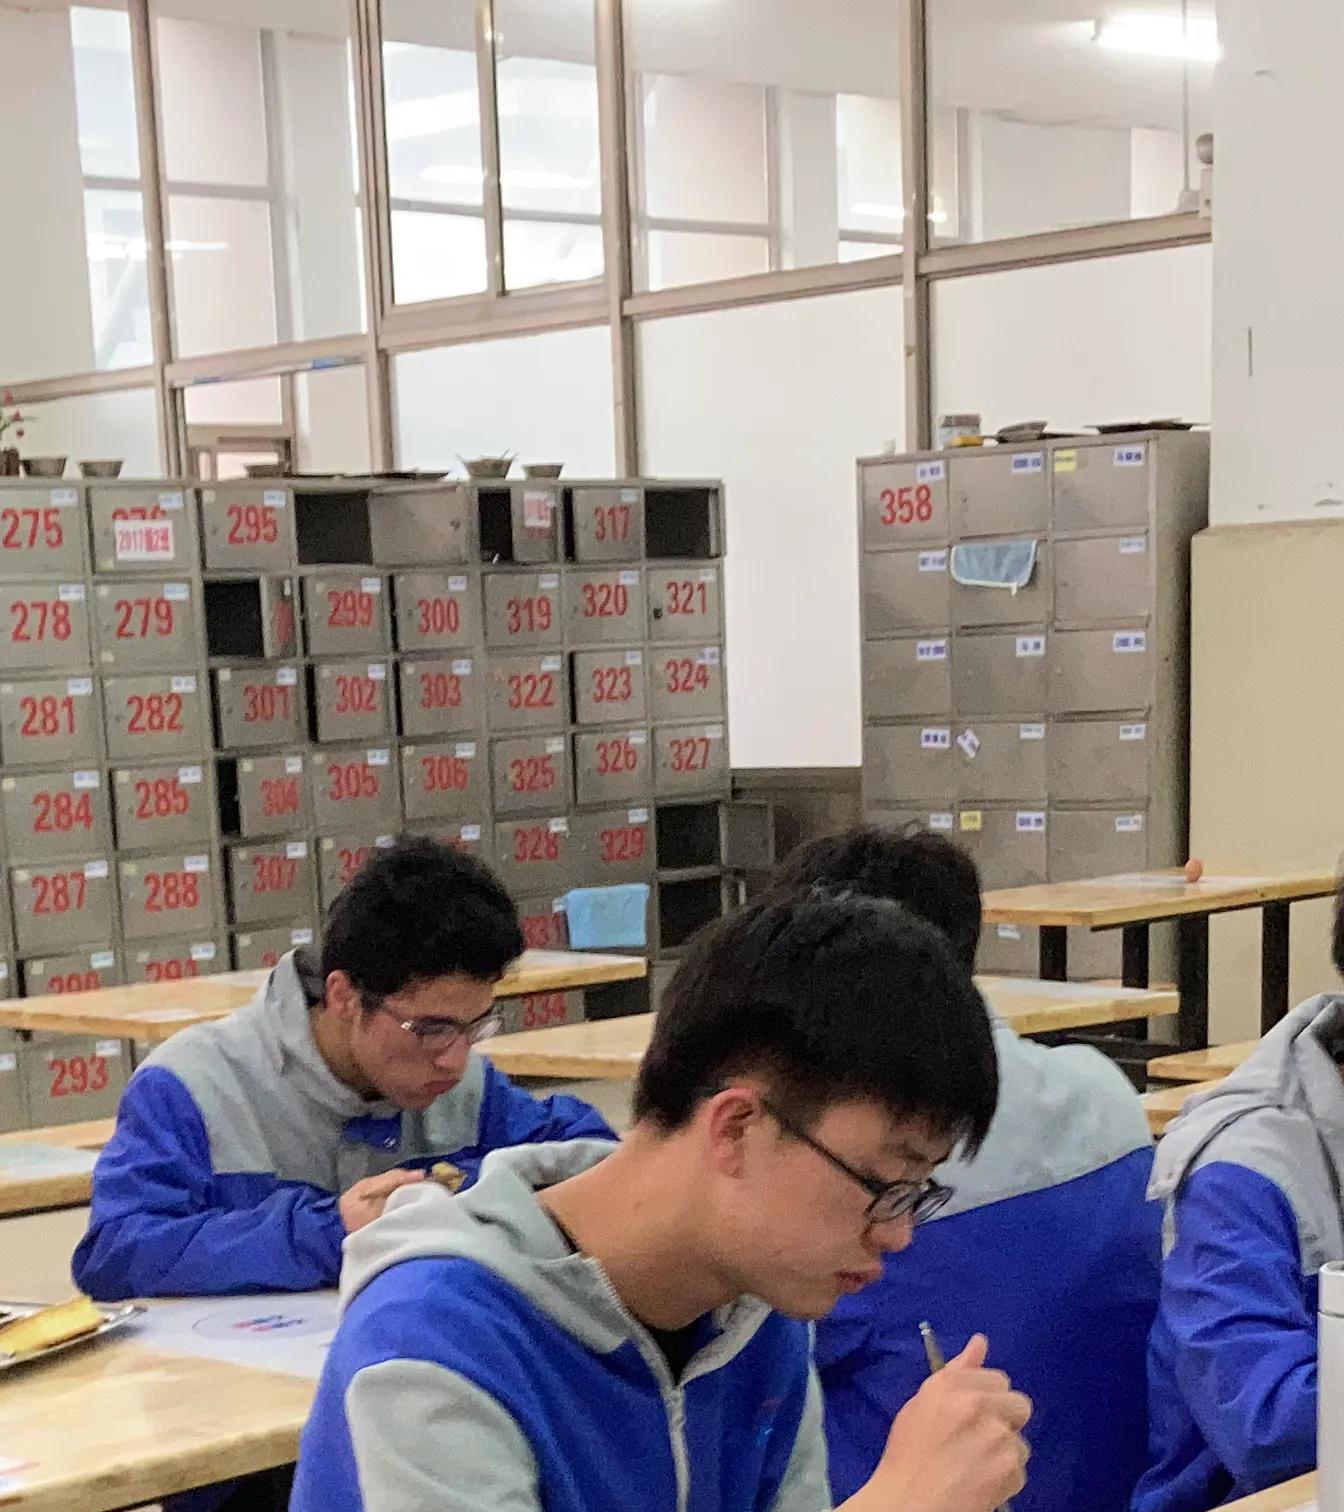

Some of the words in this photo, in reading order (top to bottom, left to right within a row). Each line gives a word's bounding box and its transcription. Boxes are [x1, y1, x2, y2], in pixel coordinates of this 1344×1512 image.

[227, 505, 277, 545] 295
[594, 503, 634, 543] 317
[879, 484, 933, 526] 358
[1, 508, 63, 549] 275
[115, 597, 174, 638] 279
[327, 590, 373, 627] 299
[415, 595, 462, 637] 300
[507, 596, 552, 635] 319
[579, 579, 630, 619] 320
[665, 579, 709, 616] 321
[10, 600, 73, 643] 278
[334, 673, 382, 716] 302
[418, 671, 465, 711] 303
[507, 673, 555, 709] 322
[591, 665, 634, 705] 323
[665, 658, 710, 694] 324
[21, 697, 74, 737] 281
[127, 693, 181, 734] 282
[243, 682, 294, 726] 301
[510, 754, 556, 793] 325
[594, 737, 639, 776] 326
[670, 735, 712, 774] 327
[330, 764, 377, 800] 305
[421, 756, 469, 794] 306
[34, 794, 93, 832] 284
[135, 779, 189, 819] 285
[32, 871, 85, 914] 287
[146, 872, 199, 912] 288
[251, 852, 300, 895] 307
[50, 1055, 108, 1097] 293
